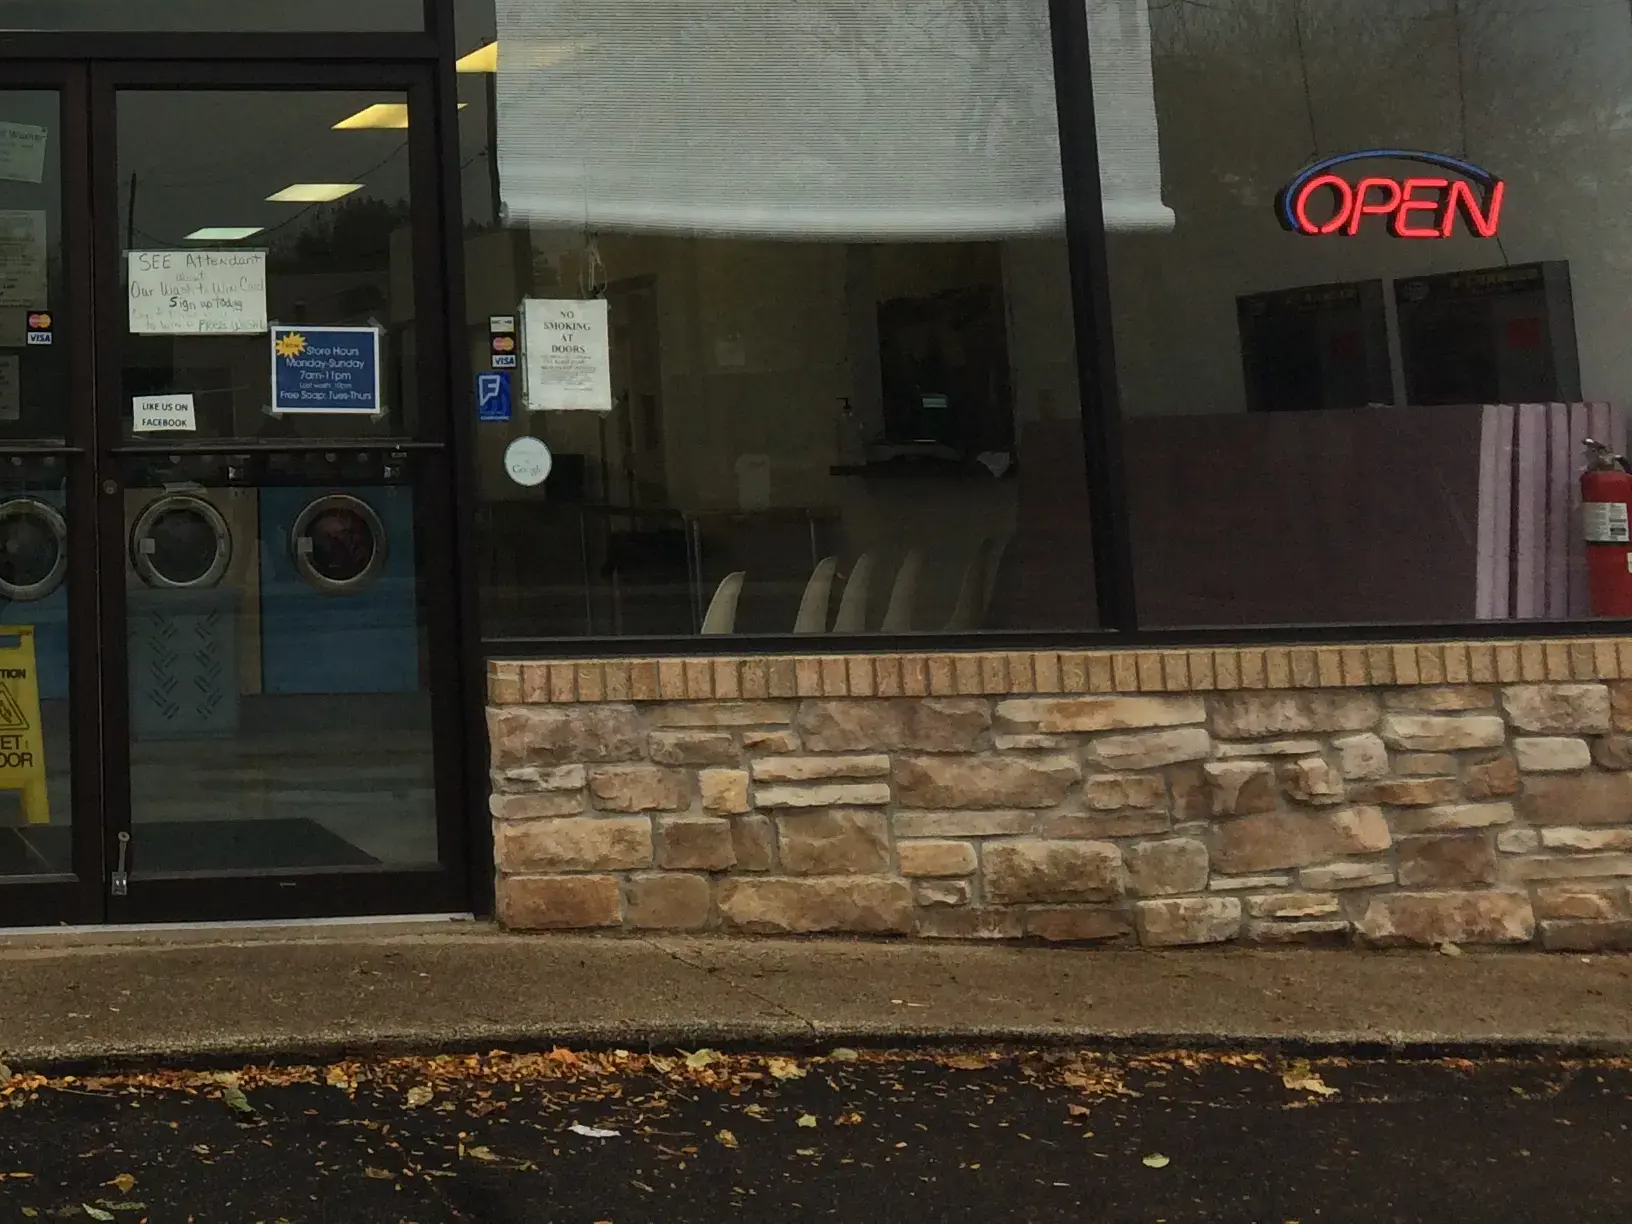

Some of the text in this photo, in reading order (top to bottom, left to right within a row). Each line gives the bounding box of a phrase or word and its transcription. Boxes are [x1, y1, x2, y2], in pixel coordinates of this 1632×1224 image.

[1296, 173, 1505, 238] OPEN
[138, 253, 172, 271] SEE
[131, 280, 154, 298] Our
[169, 296, 196, 312] Sign
[560, 310, 574, 319] NO
[543, 322, 591, 331] SMOKING
[29, 334, 50, 342] VISA
[560, 334, 574, 342] AT
[306, 346, 360, 356] Store Hours
[551, 344, 586, 354] DOORS
[286, 358, 365, 369] Monday-Sunday
[494, 357, 515, 365] VISA
[299, 370, 352, 381] 7am-11pm
[280, 390, 299, 400] Free
[142, 402, 188, 412] LIKE US ON
[142, 418, 188, 428] FACEBOOK
